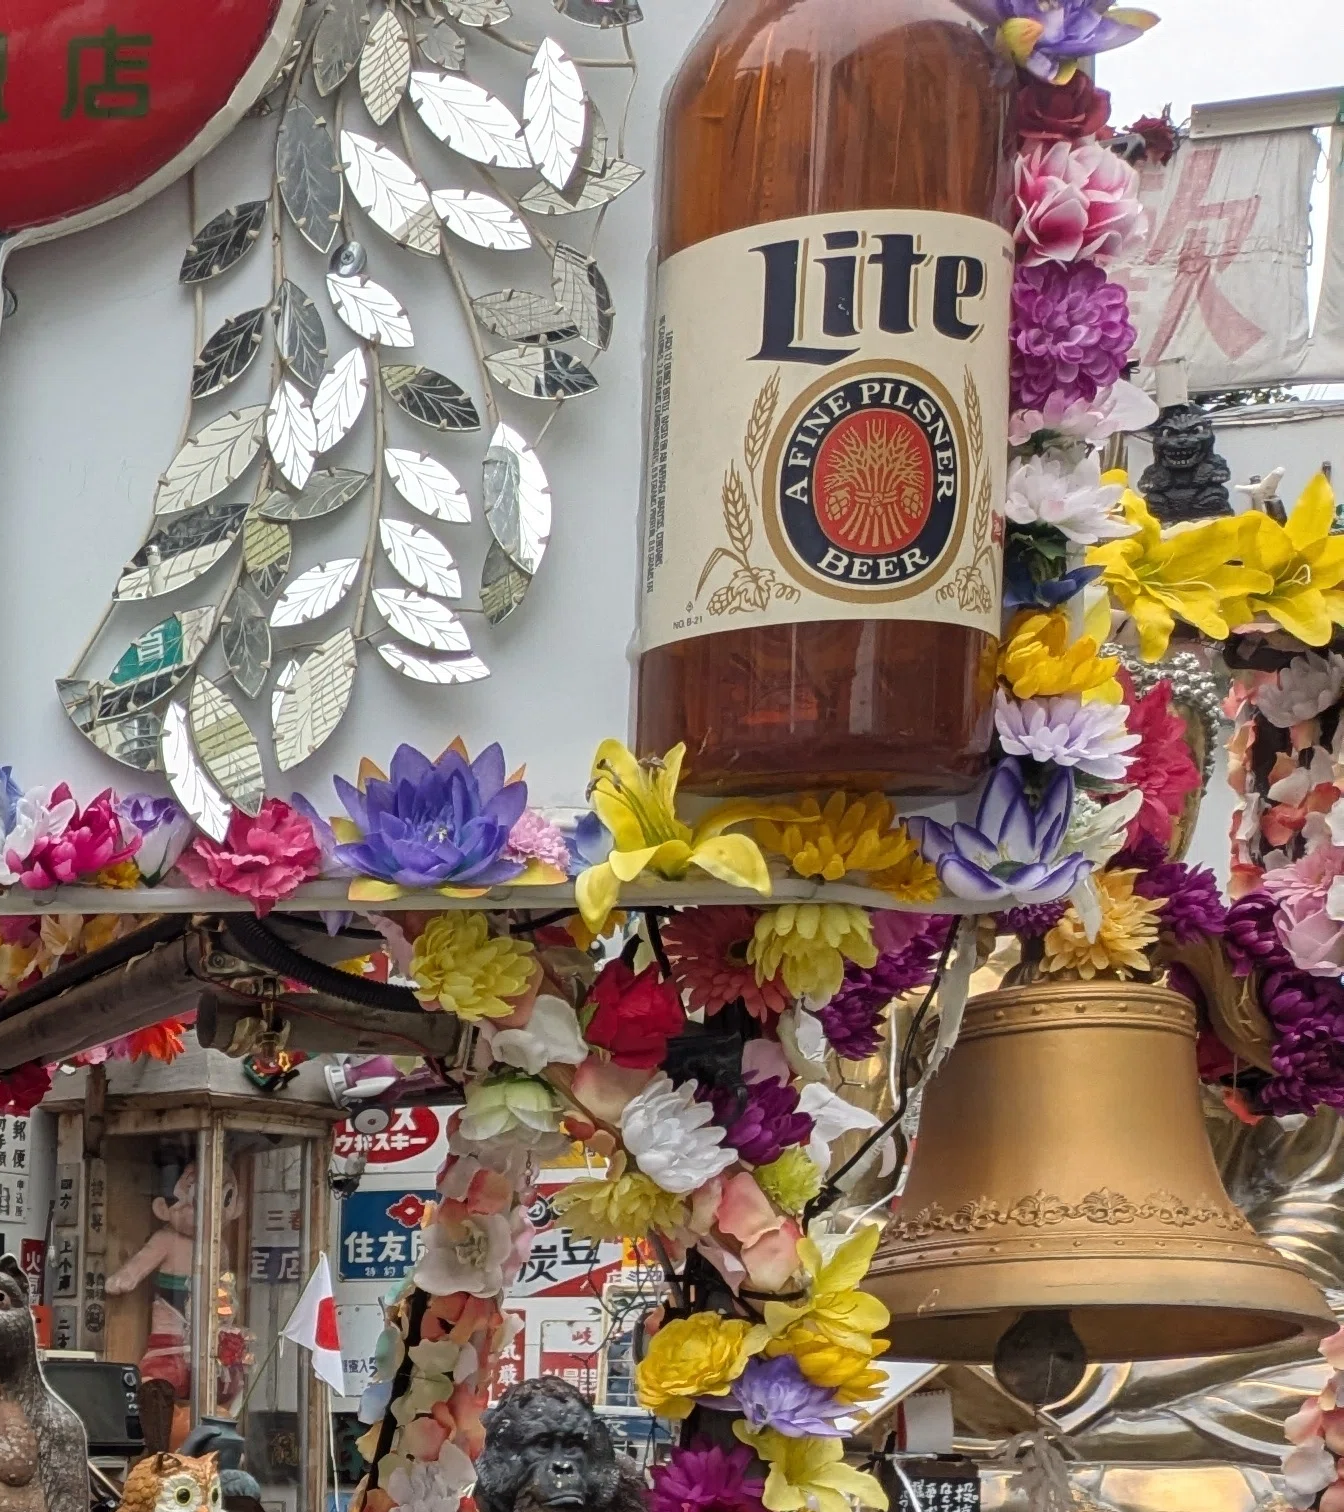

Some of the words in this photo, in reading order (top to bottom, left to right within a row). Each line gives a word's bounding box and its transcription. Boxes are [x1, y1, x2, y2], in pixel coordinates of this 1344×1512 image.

[746, 229, 990, 367] Lite
[787, 389, 853, 469] FINE
[858, 380, 957, 504] PILSNER
[784, 476, 809, 505] A
[815, 545, 932, 582] BEER
